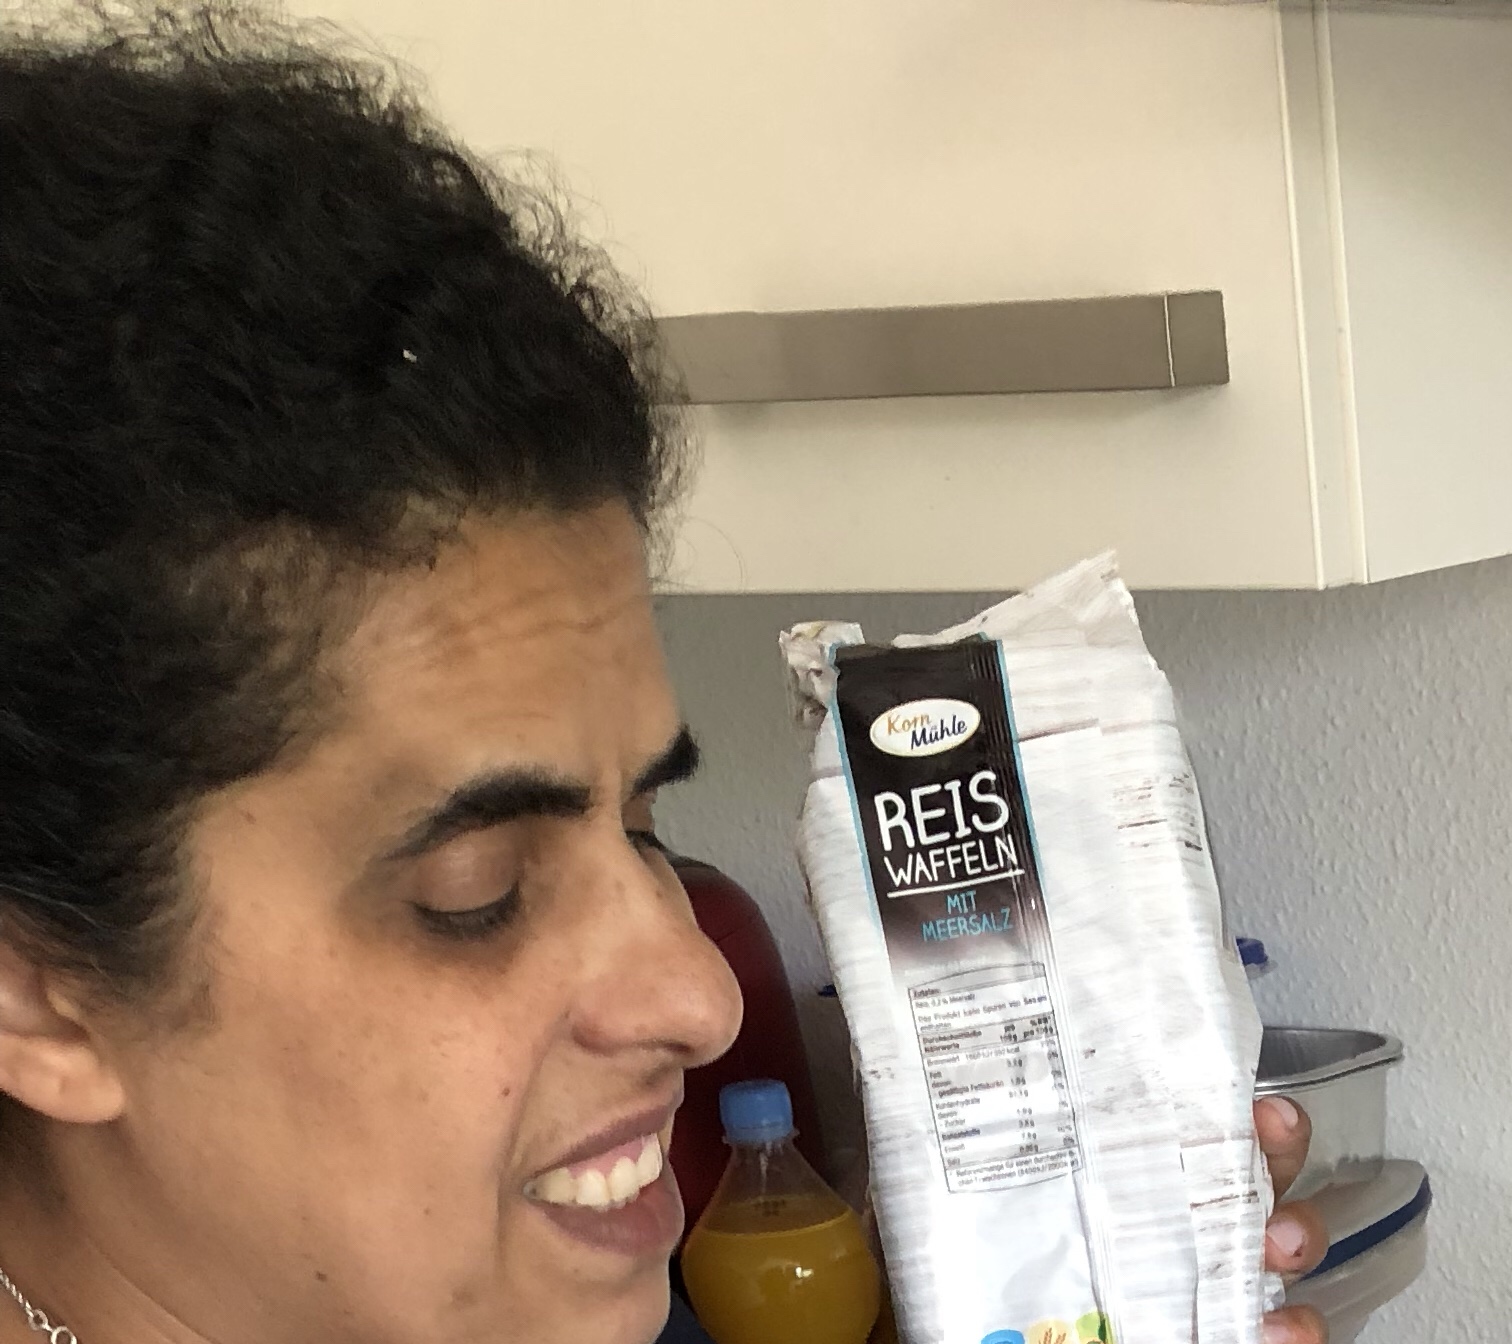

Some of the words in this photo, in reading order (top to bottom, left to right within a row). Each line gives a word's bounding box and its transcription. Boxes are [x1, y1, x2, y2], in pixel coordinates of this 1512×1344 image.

[887, 711, 932, 736] Korn
[910, 714, 968, 750] Mühle
[873, 769, 1010, 852] REIS
[883, 833, 1019, 888] WAFFELN
[946, 890, 977, 915] MIT
[920, 907, 1014, 942] MEERSALZ
